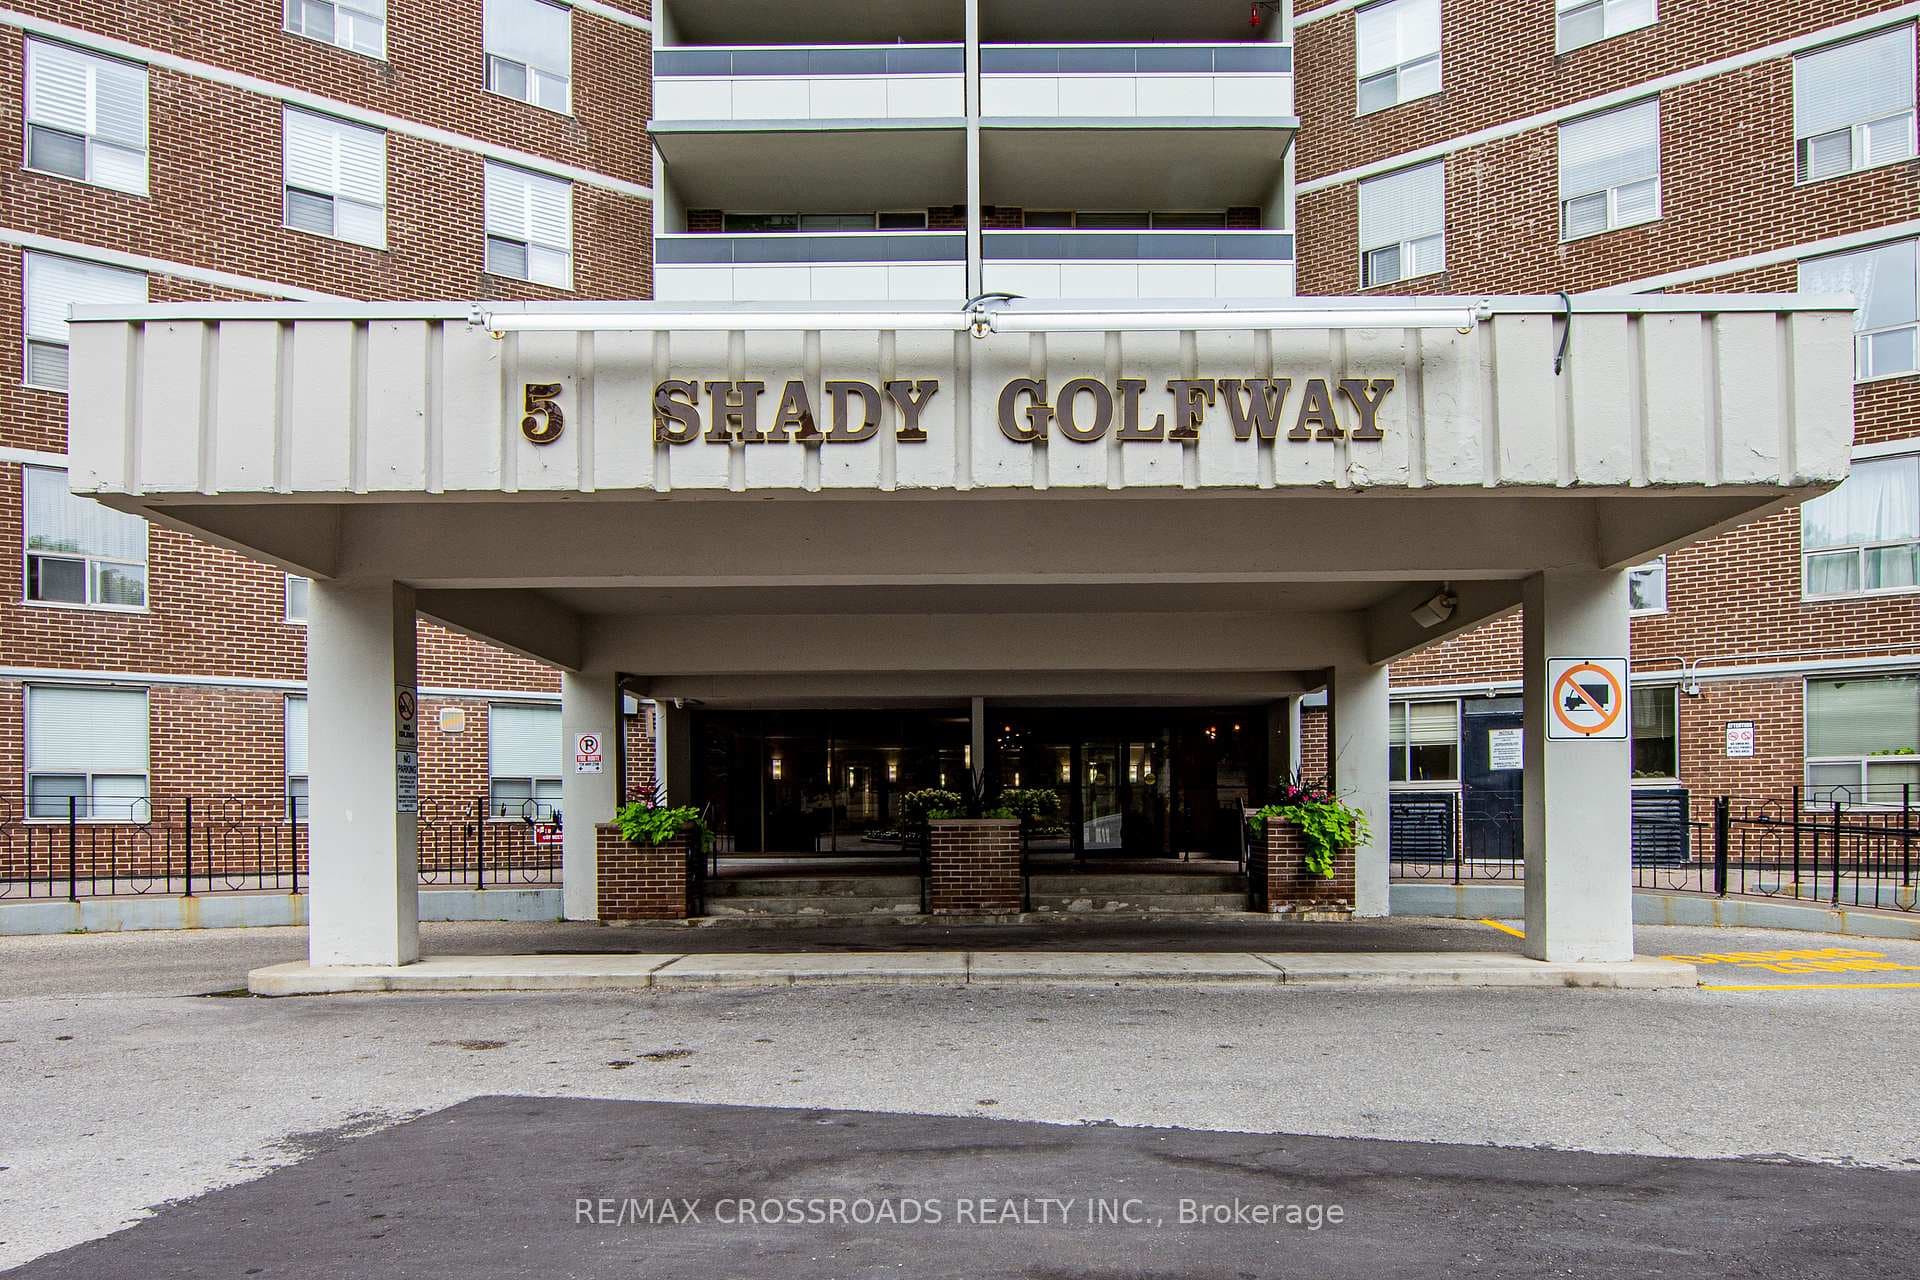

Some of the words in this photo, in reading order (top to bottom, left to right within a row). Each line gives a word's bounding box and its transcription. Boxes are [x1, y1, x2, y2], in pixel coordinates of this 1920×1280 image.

[520, 382, 564, 444] 5
[652, 377, 939, 444] SHADY
[996, 376, 1395, 442] GOLFWAY
[403, 755, 411, 764] NO
